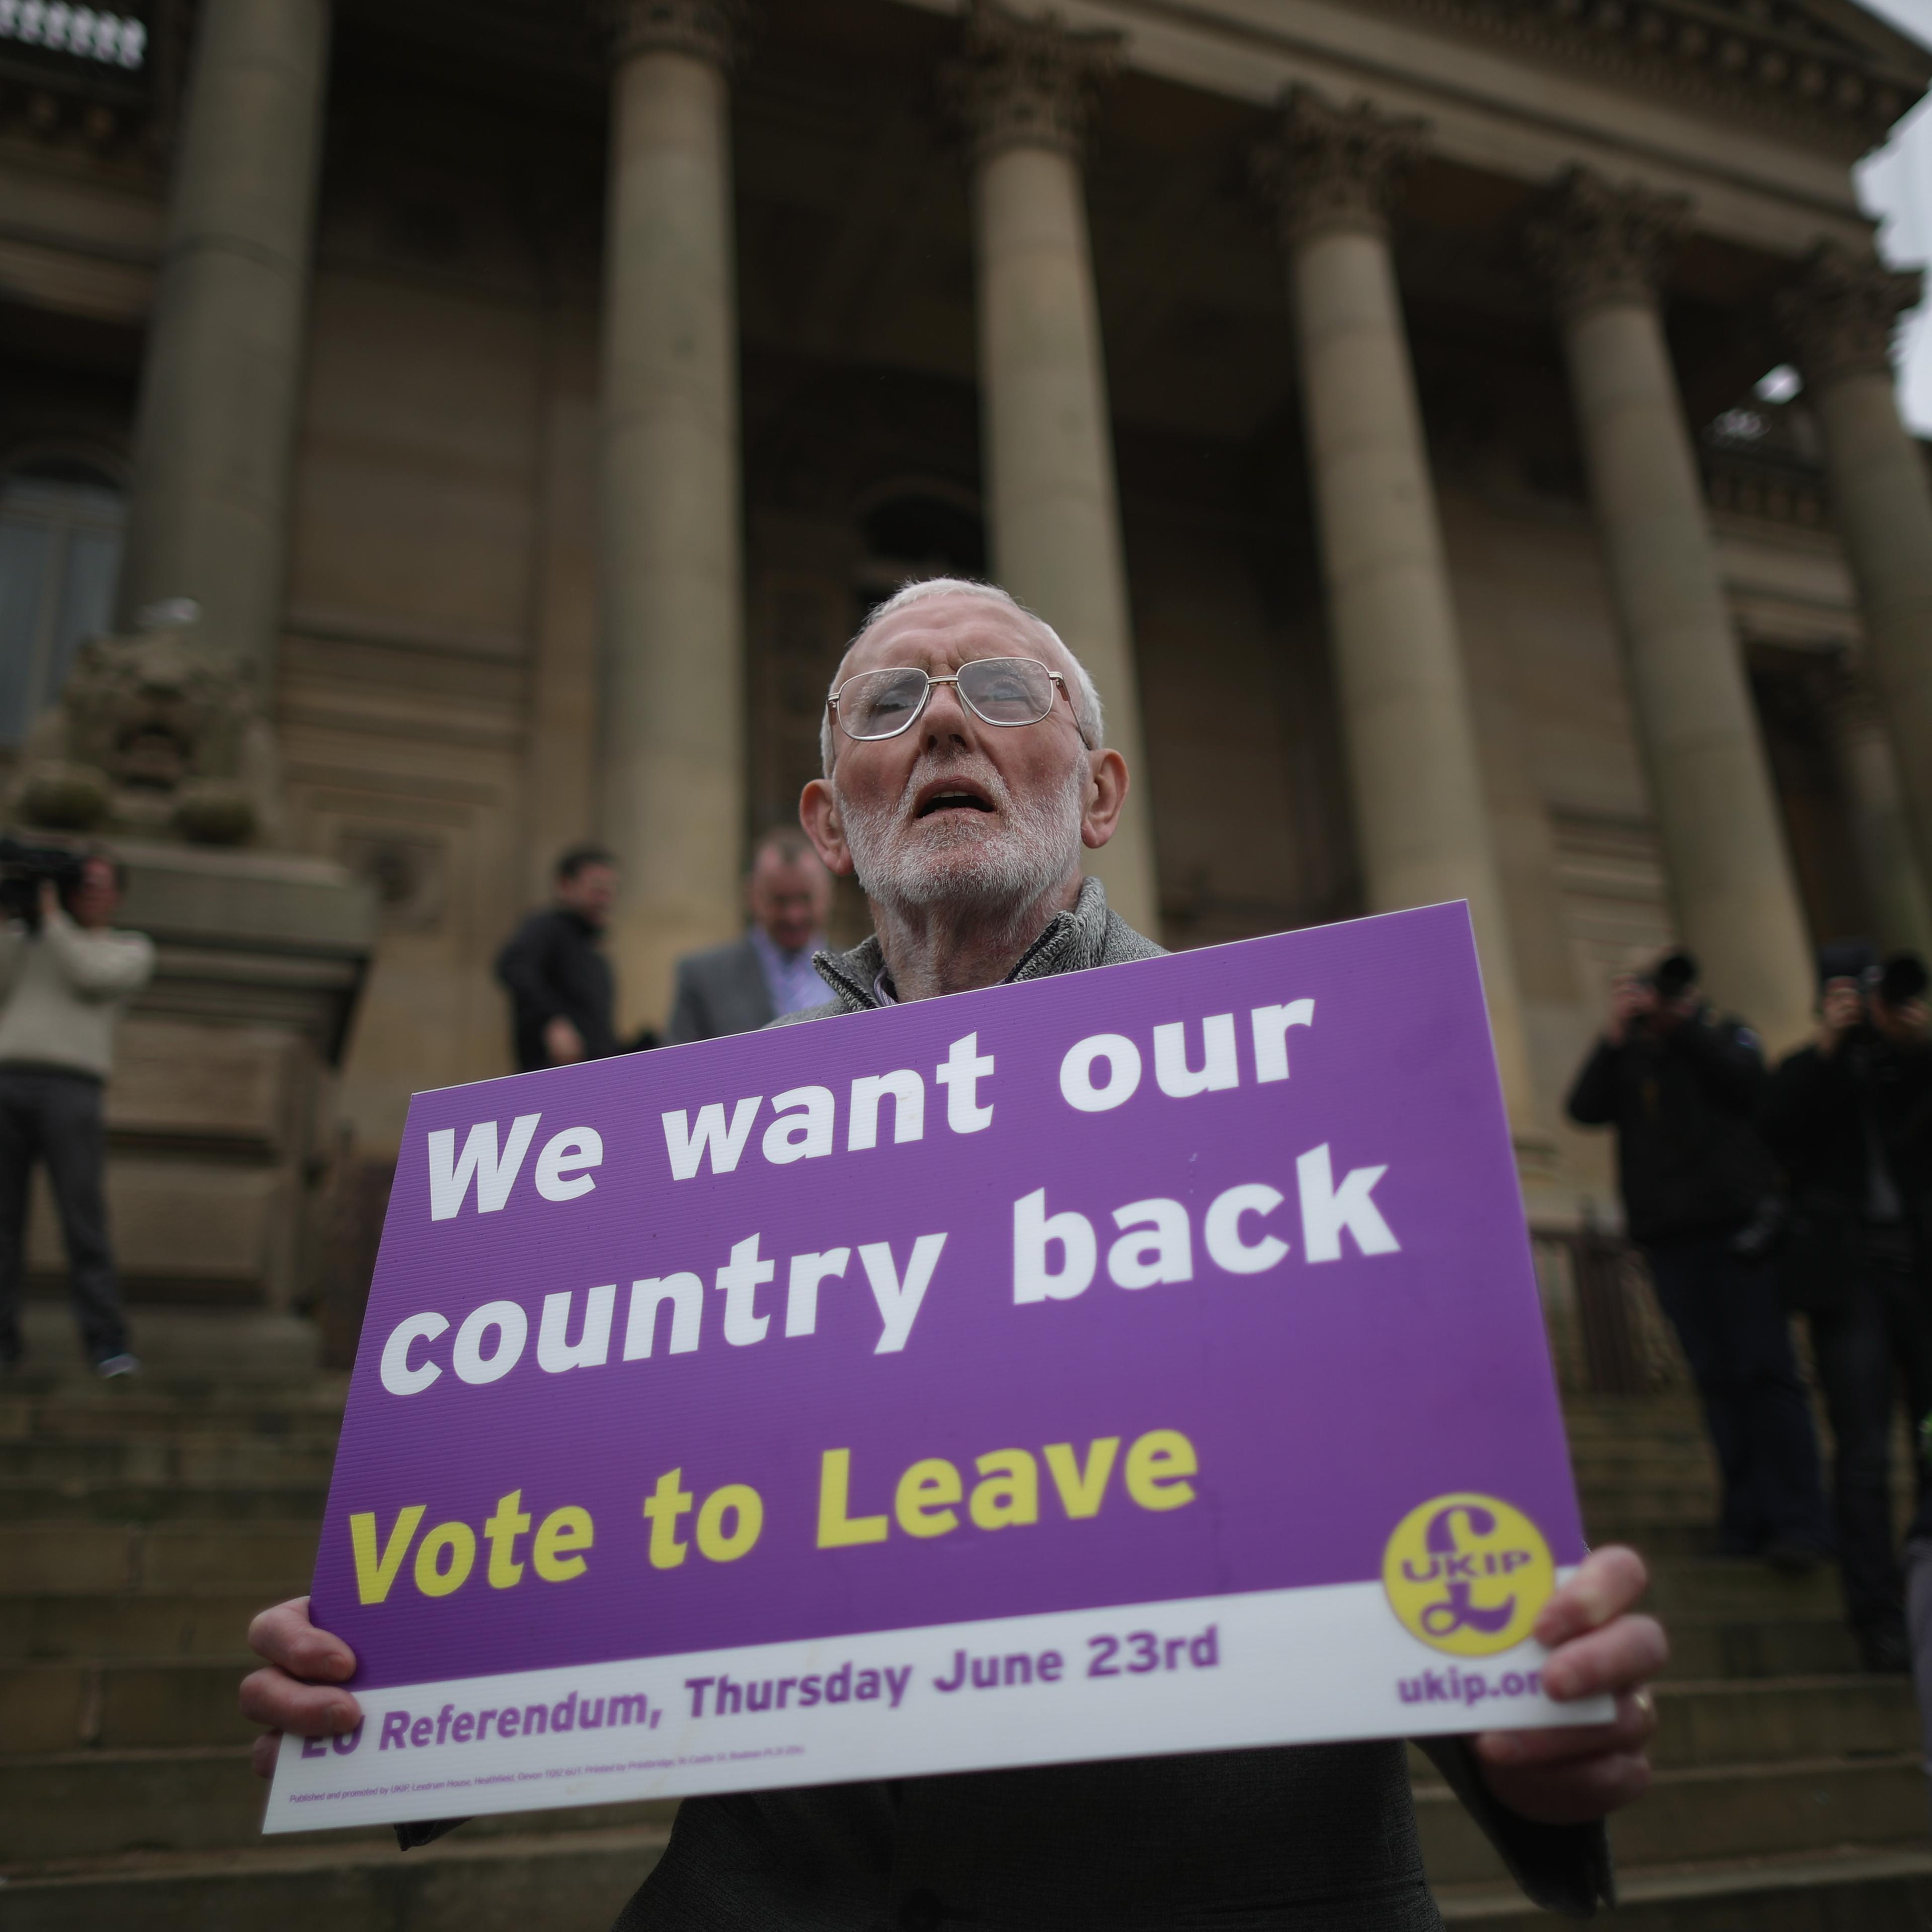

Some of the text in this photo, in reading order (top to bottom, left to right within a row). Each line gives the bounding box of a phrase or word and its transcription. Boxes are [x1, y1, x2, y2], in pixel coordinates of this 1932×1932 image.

[427, 997, 1316, 1222] We want our
[379, 1142, 1402, 1396] country back
[350, 1430, 1197, 1606] Vote to Leave
[1402, 1549, 1532, 1583] UKIP
[379, 1692, 662, 1751] Referendum,
[685, 1662, 912, 1718] Thursday
[934, 1650, 1063, 1692] June
[1088, 1626, 1219, 1677] 23rd
[1398, 1667, 1543, 1705] ukip.or
[289, 1792, 325, 1803] Published
[327, 1791, 341, 1800] and
[342, 1788, 378, 1800] promoted
[379, 1787, 388, 1795] by
